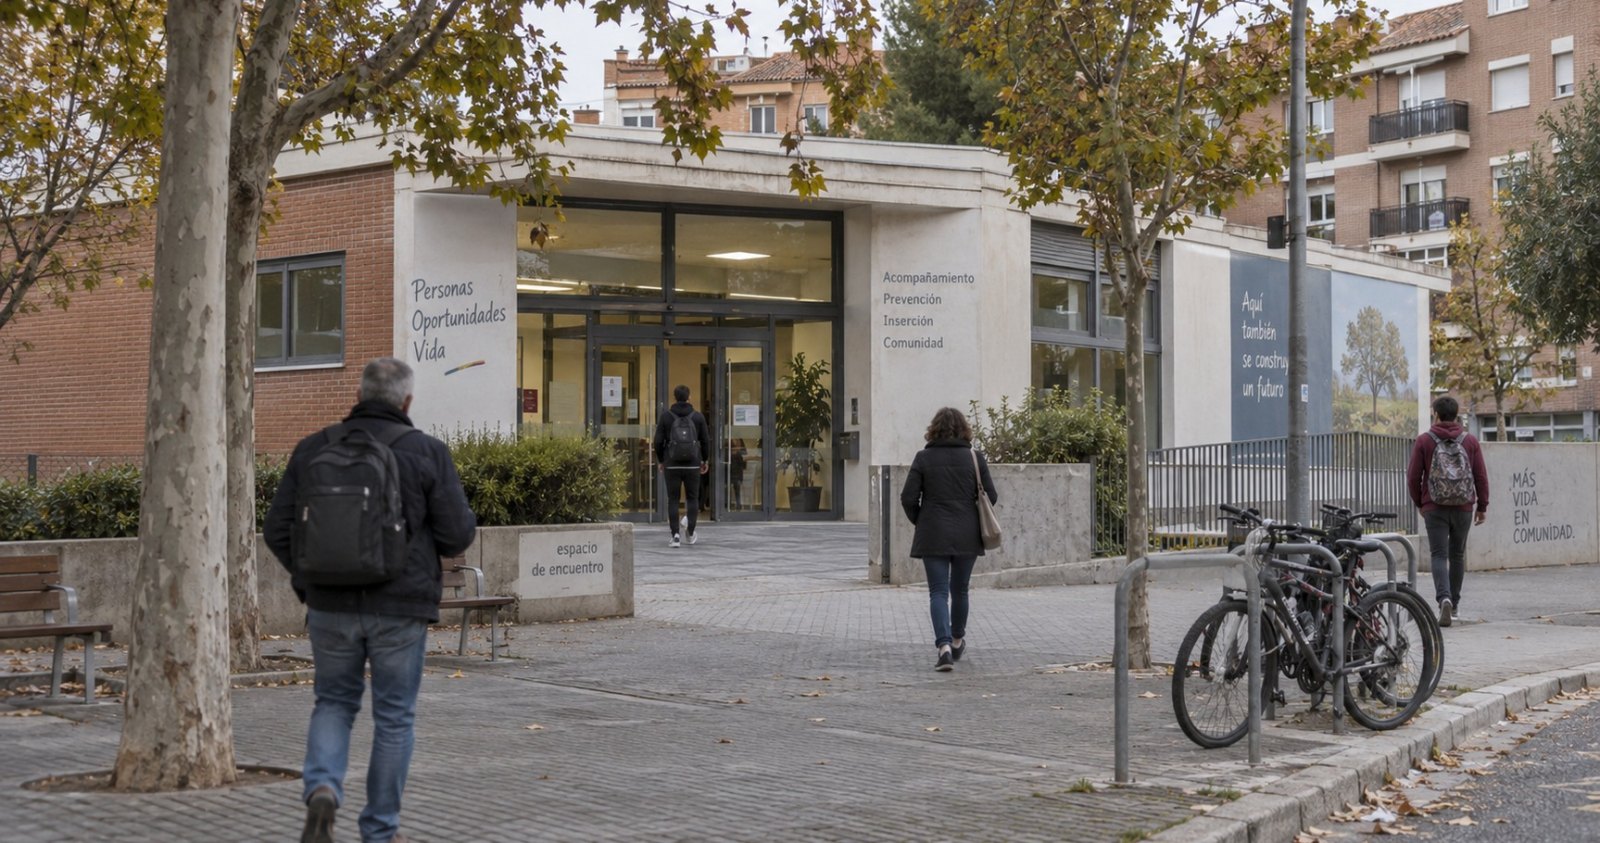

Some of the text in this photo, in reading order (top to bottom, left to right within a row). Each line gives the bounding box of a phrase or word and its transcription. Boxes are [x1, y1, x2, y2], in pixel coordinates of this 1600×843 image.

[883, 272, 975, 286] Acompañamiento
[411, 278, 474, 302] Personas
[883, 293, 942, 305] Prevención
[1242, 290, 1263, 319] Aquí
[412, 301, 506, 336] Oportunidades
[883, 315, 934, 326] Inserción
[1242, 320, 1277, 341] también
[414, 338, 445, 362] Vida
[883, 336, 944, 349] Comunidad
[1242, 350, 1290, 376] se construy
[1243, 375, 1284, 402] un futuro
[1512, 467, 1536, 489] MÁS
[1512, 491, 1539, 507] VIDA
[1514, 509, 1530, 526] EN
[556, 541, 598, 558] espacio
[532, 561, 604, 577] de encuentro
